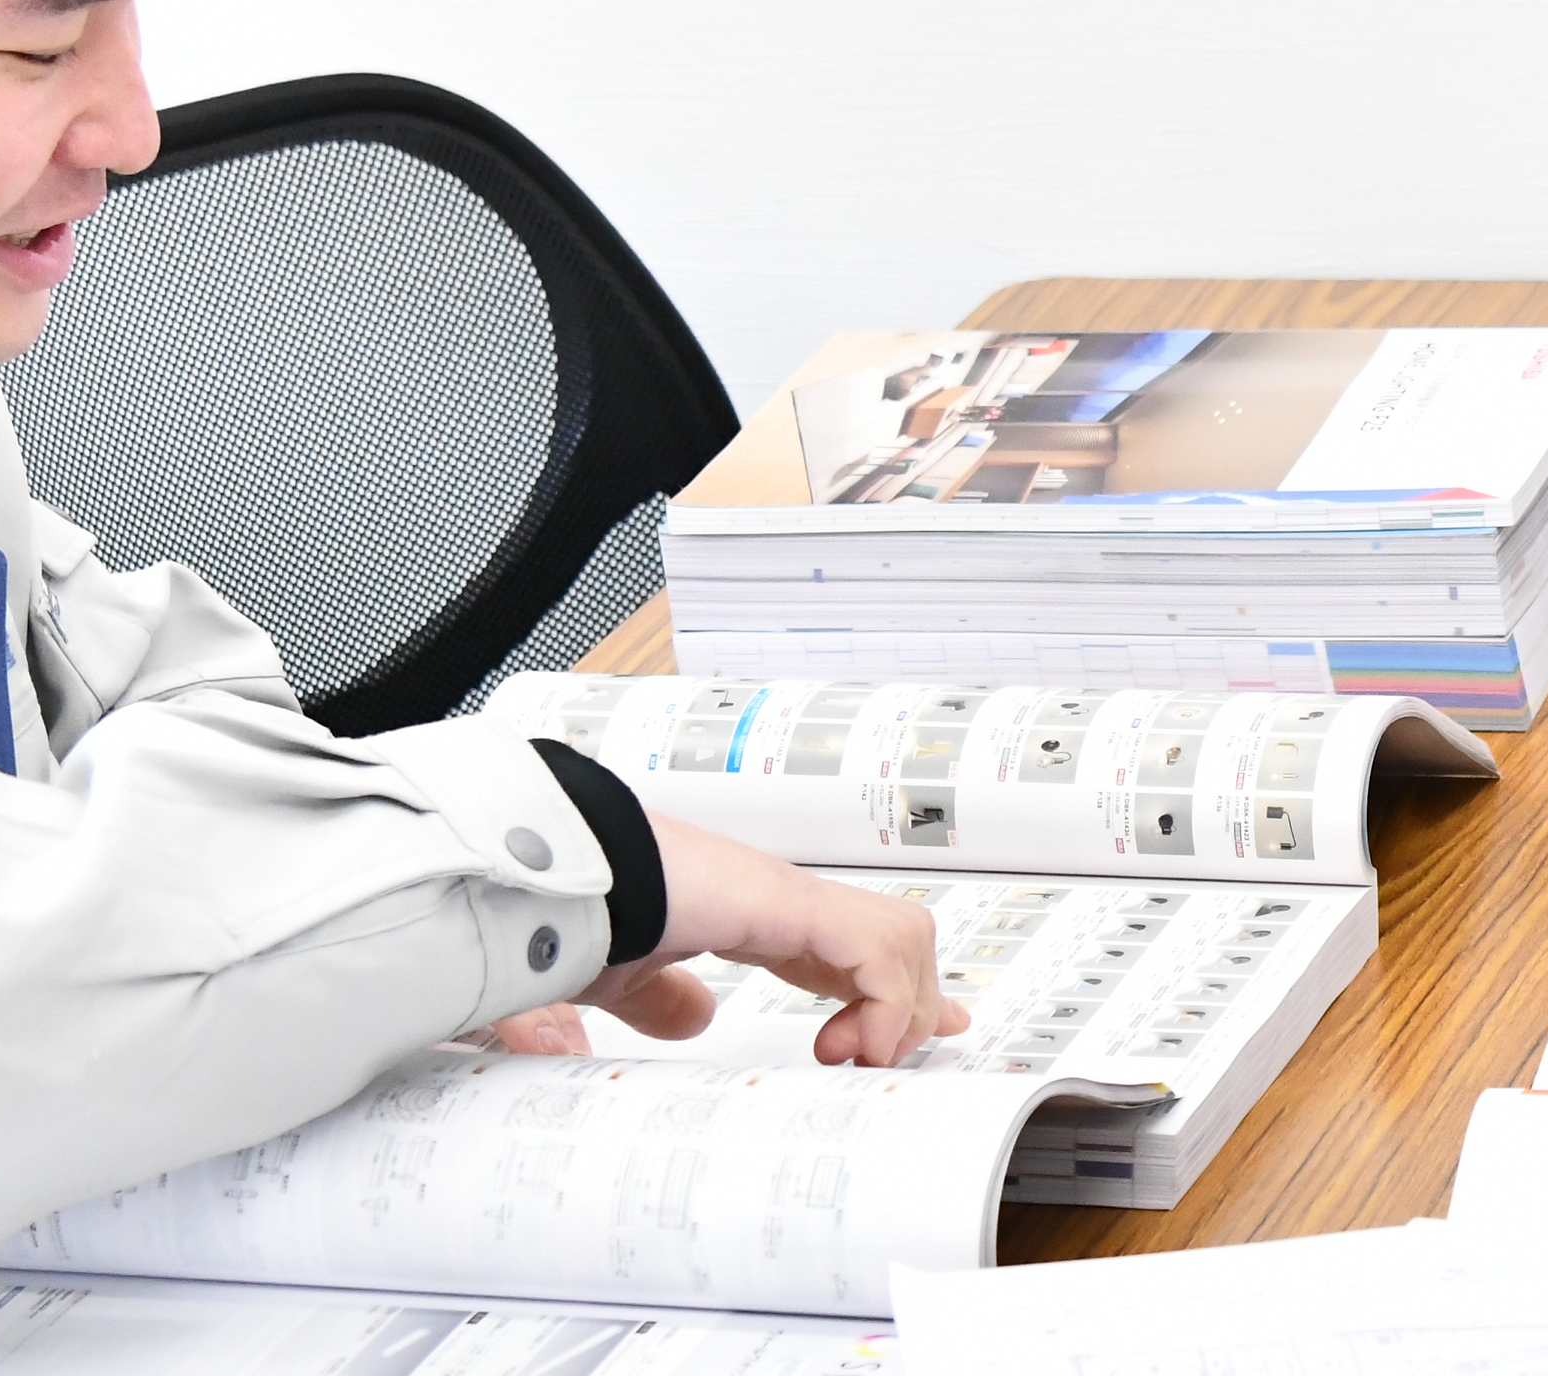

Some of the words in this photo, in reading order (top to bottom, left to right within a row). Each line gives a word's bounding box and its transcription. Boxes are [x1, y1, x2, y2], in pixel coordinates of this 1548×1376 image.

[1403, 342, 1439, 369] HOME
[1371, 370, 1413, 413] LIGHTING
[1358, 414, 1390, 433] F25
[1096, 791, 1104, 809] P.138
[1123, 798, 1131, 837] DBK-41436
